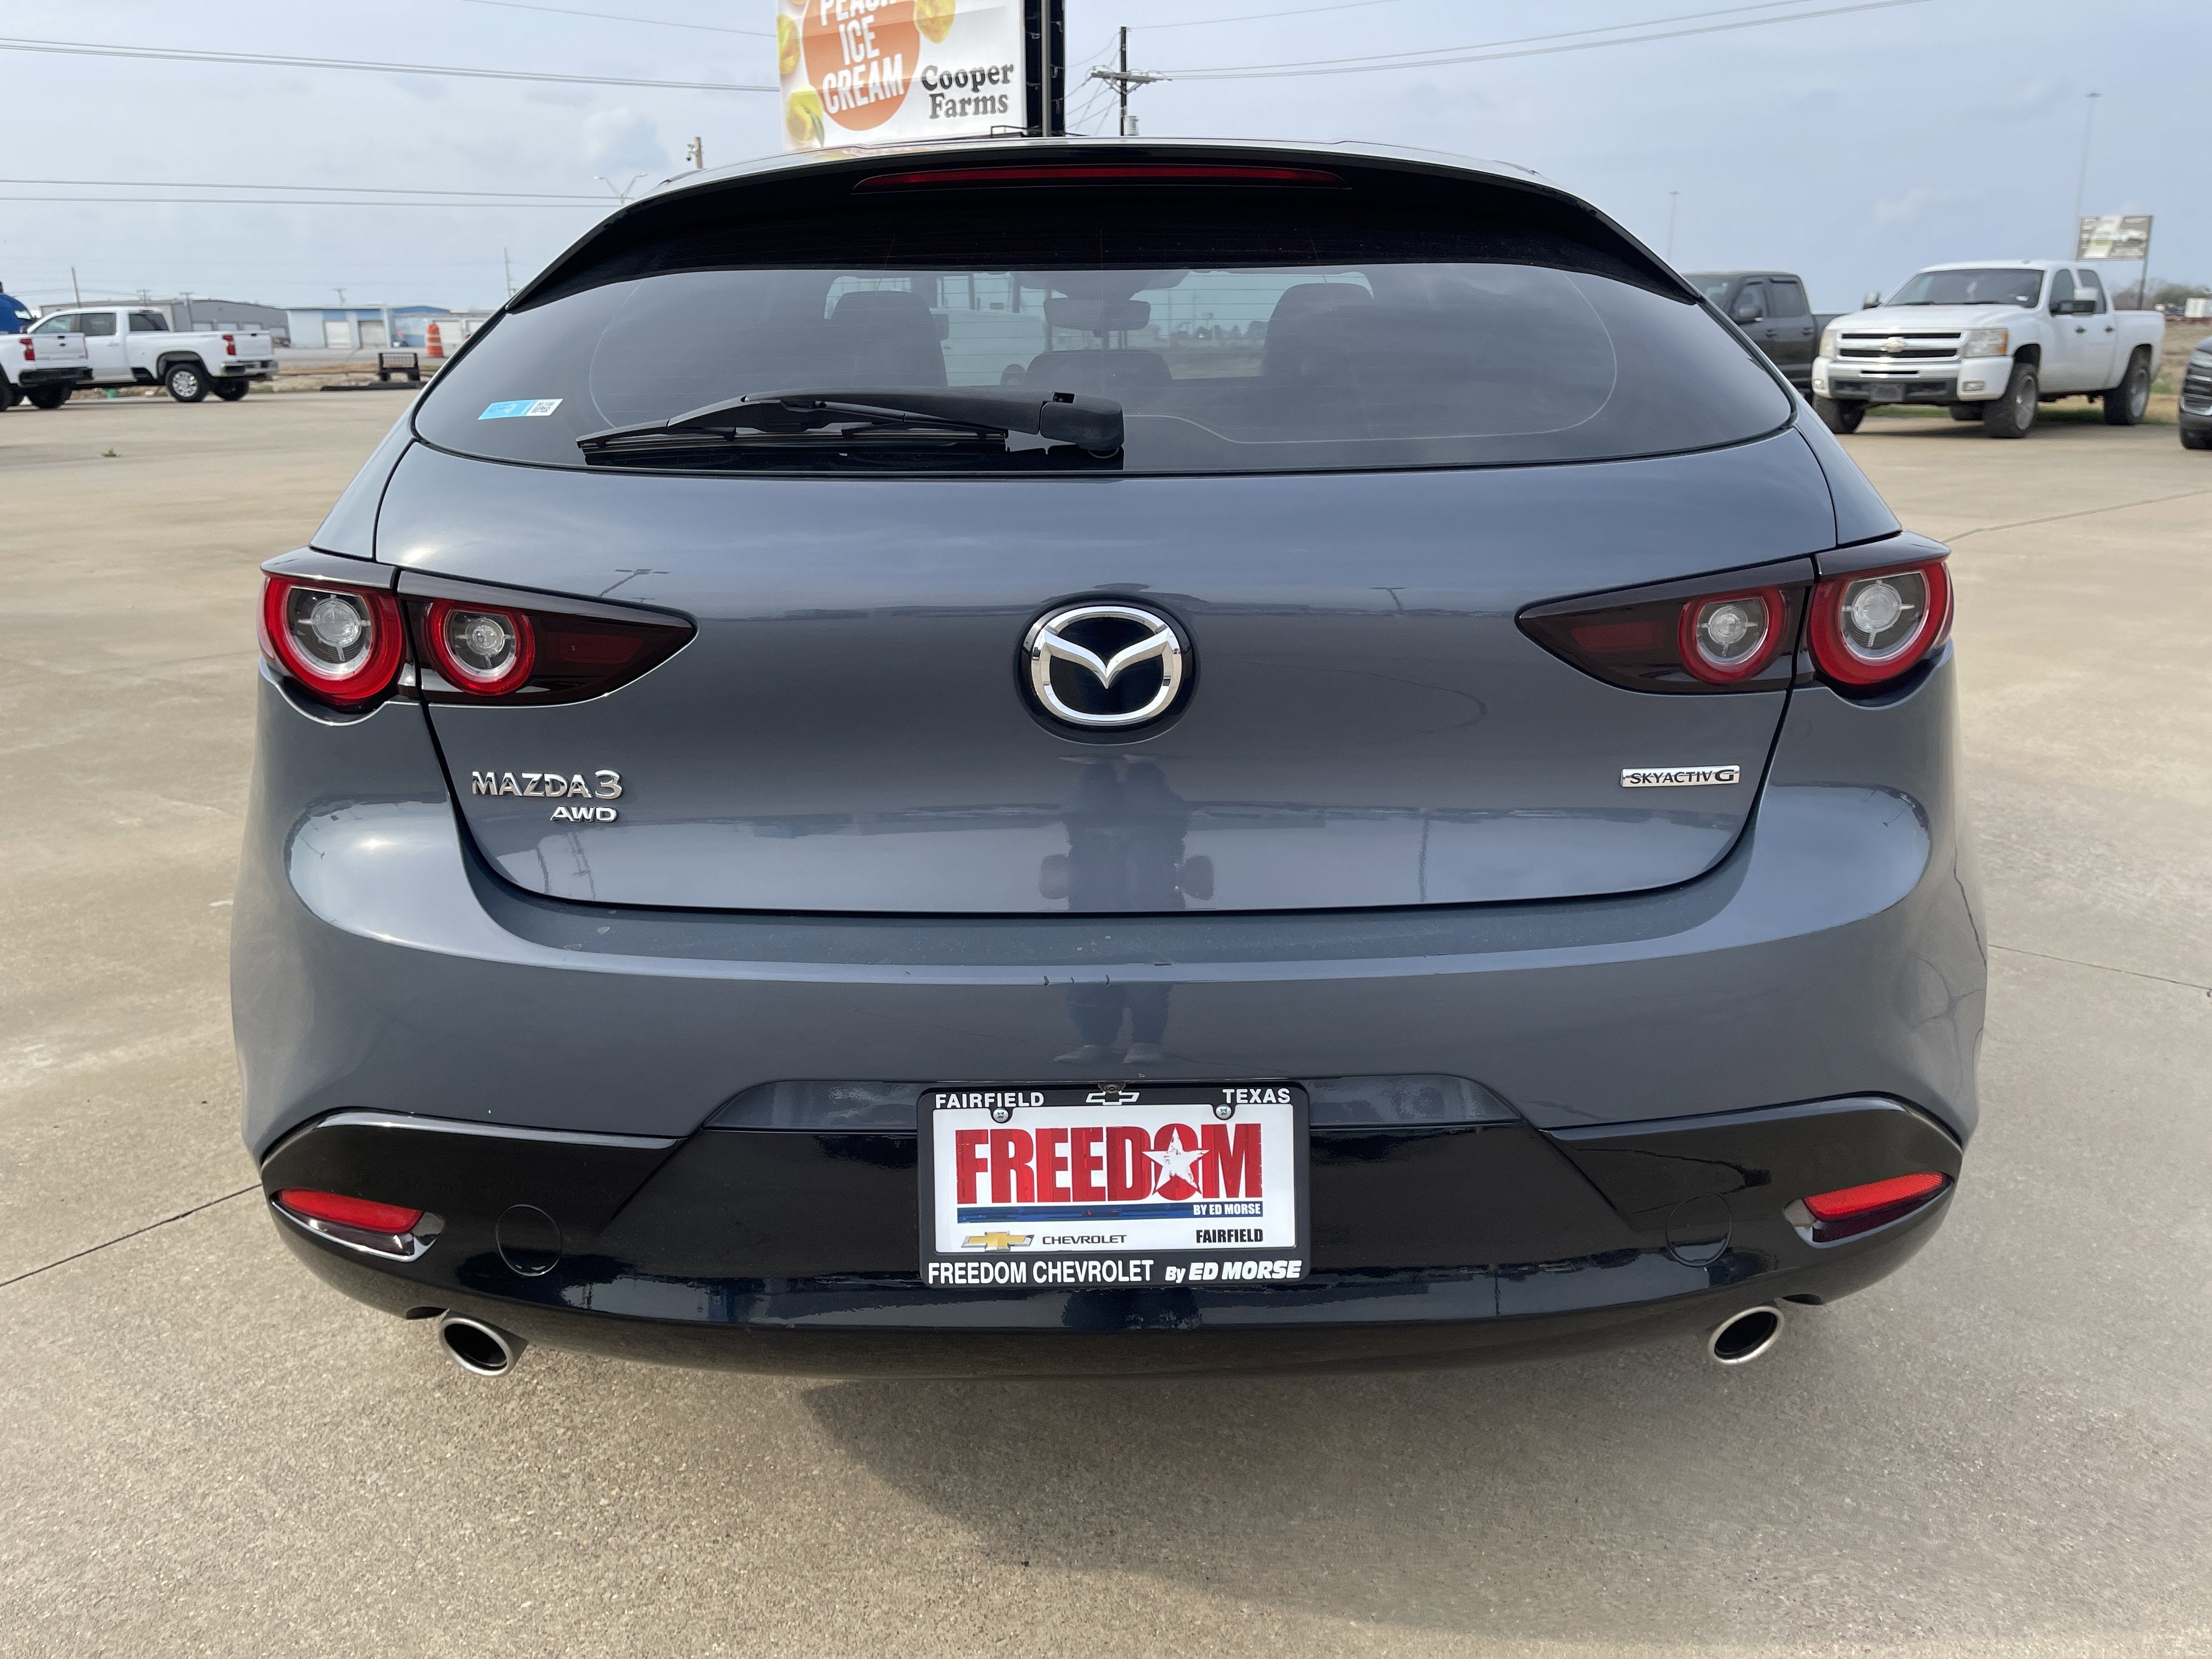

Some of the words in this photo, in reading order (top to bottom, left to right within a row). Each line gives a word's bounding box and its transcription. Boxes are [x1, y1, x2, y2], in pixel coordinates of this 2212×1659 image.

[838, 14, 881, 65] ICE
[822, 53, 905, 114] CREAM
[921, 64, 1014, 92] Cooper
[928, 92, 1008, 119] Farms
[550, 806, 618, 822] AWD
[935, 1093, 1044, 1109] FAIRFIELD
[1223, 1088, 1291, 1104] TEXAS
[955, 1123, 1263, 1203] FREEDOM
[1193, 1205, 1207, 1215] BY
[1209, 1204, 1222, 1215] ED
[1224, 1203, 1261, 1215] MORSE
[1042, 1234, 1127, 1245] CHEVROLET
[1196, 1228, 1263, 1243] FAIRFIELD
[928, 1262, 1026, 1284] FREEDOM
[1034, 1260, 1154, 1283] CHEVROLET
[1165, 1267, 1186, 1283] By
[1188, 1262, 1217, 1280] ED
[1221, 1260, 1302, 1280] MORSE
